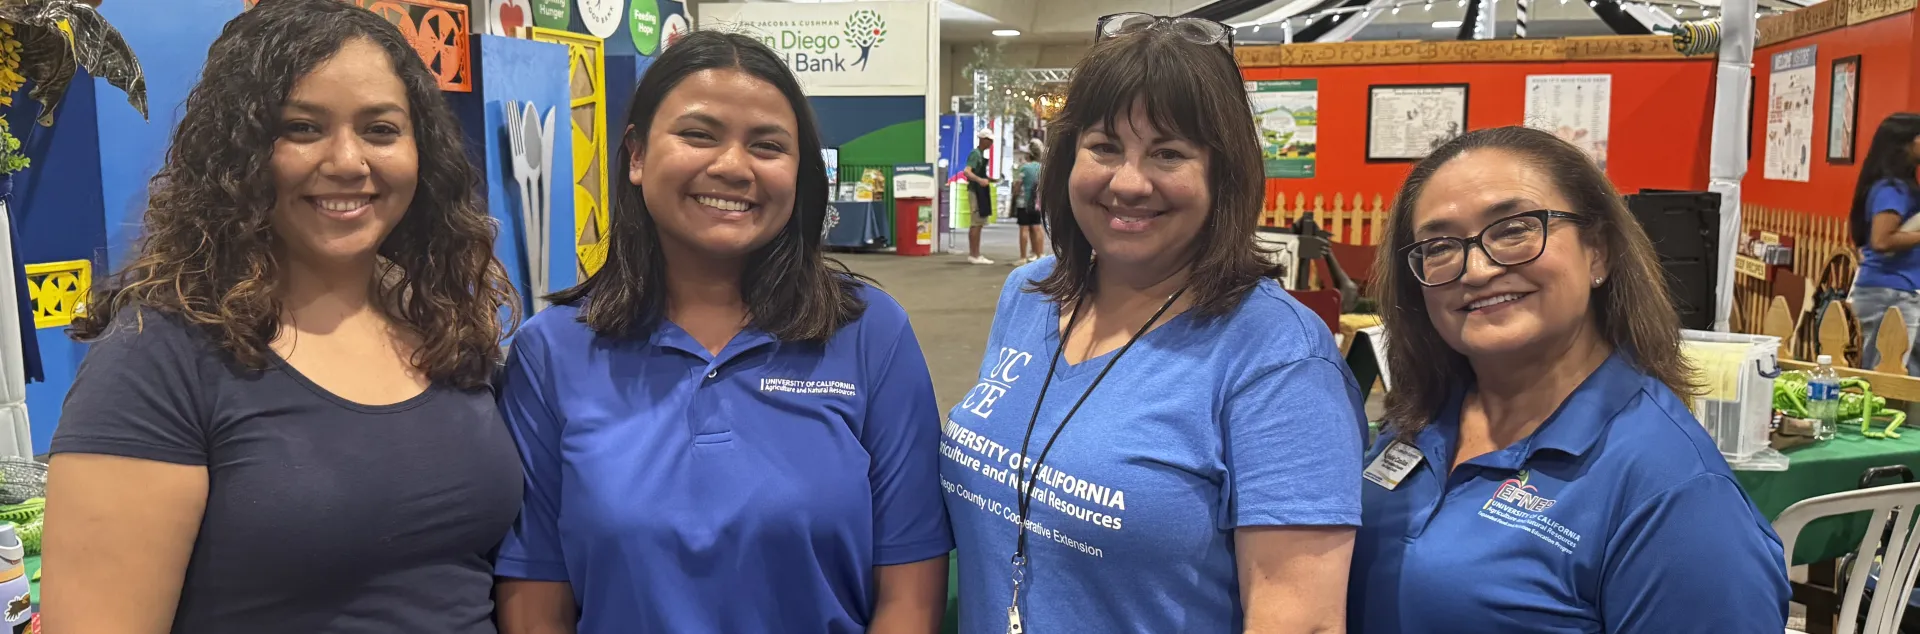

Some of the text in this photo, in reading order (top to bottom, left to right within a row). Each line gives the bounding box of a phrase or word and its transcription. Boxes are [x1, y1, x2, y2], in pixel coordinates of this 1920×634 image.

[539, 4, 564, 20] Hunger
[634, 8, 656, 25] Feeding
[637, 22, 654, 36] Hope
[781, 30, 840, 54] Diego
[795, 52, 846, 72] Bank
[990, 347, 1032, 382] UC
[765, 378, 804, 387] UNIVERSITY
[816, 380, 855, 390] CALIFORNIA
[765, 384, 795, 393] Agriculture
[829, 387, 856, 396] Resources
[962, 382, 1006, 419] CE
[982, 464, 1008, 484] and
[1049, 491, 1122, 530] Resources
[956, 484, 987, 511] County
[988, 498, 1002, 516] UC
[1053, 529, 1102, 558] Extension
[1487, 506, 1517, 522] Agriculture
[1546, 527, 1576, 548] Resources
[1491, 500, 1528, 519] UNIVERSITY
[1537, 514, 1581, 542] CALIFORNIA
[1531, 528, 1555, 545] Education
